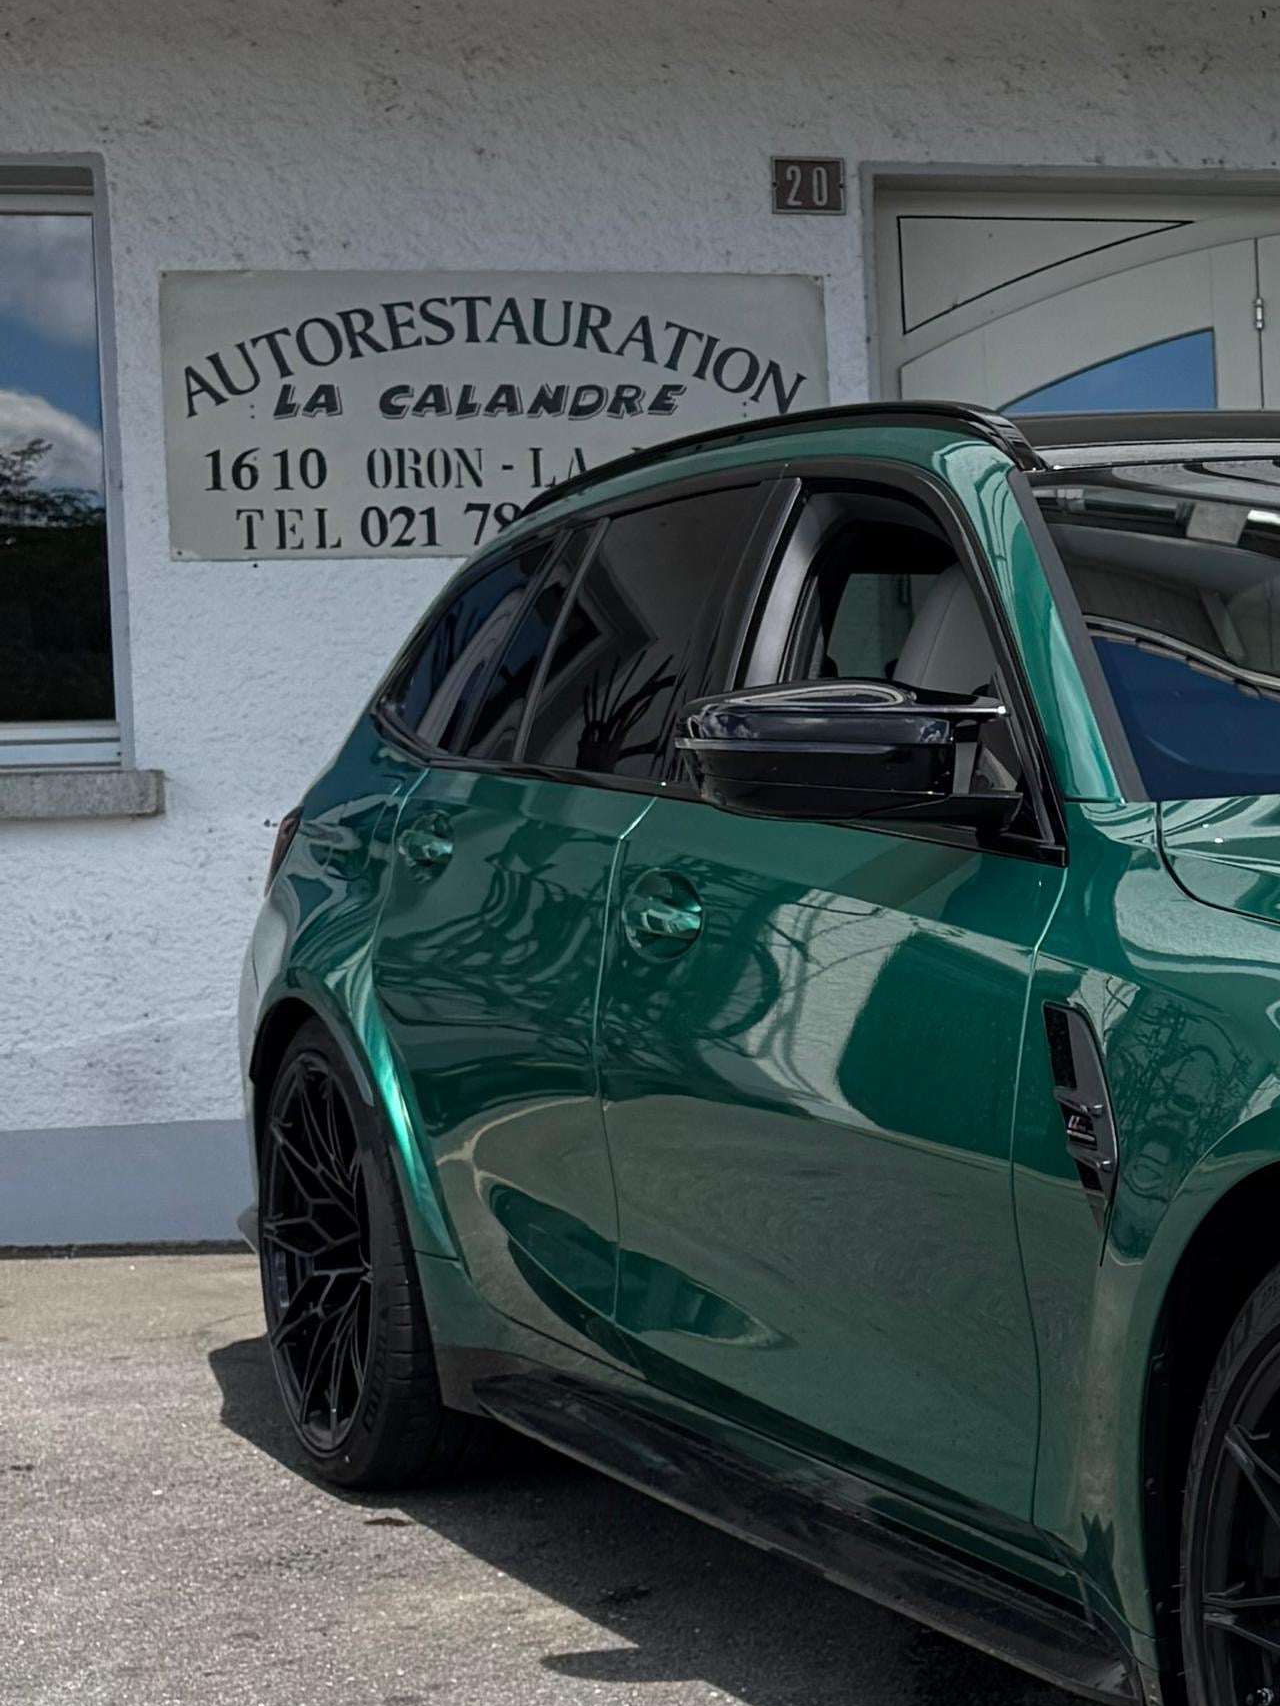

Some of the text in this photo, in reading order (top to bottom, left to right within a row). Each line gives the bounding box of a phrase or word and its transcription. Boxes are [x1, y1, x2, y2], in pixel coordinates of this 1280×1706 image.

[785, 165, 829, 207] 20
[183, 295, 807, 417] AUTORESTAURATION
[273, 383, 688, 420] LA CALANDRE
[205, 447, 328, 492] 1610
[366, 447, 484, 489] ORON
[236, 507, 342, 550] TEL
[360, 505, 440, 548] 021
